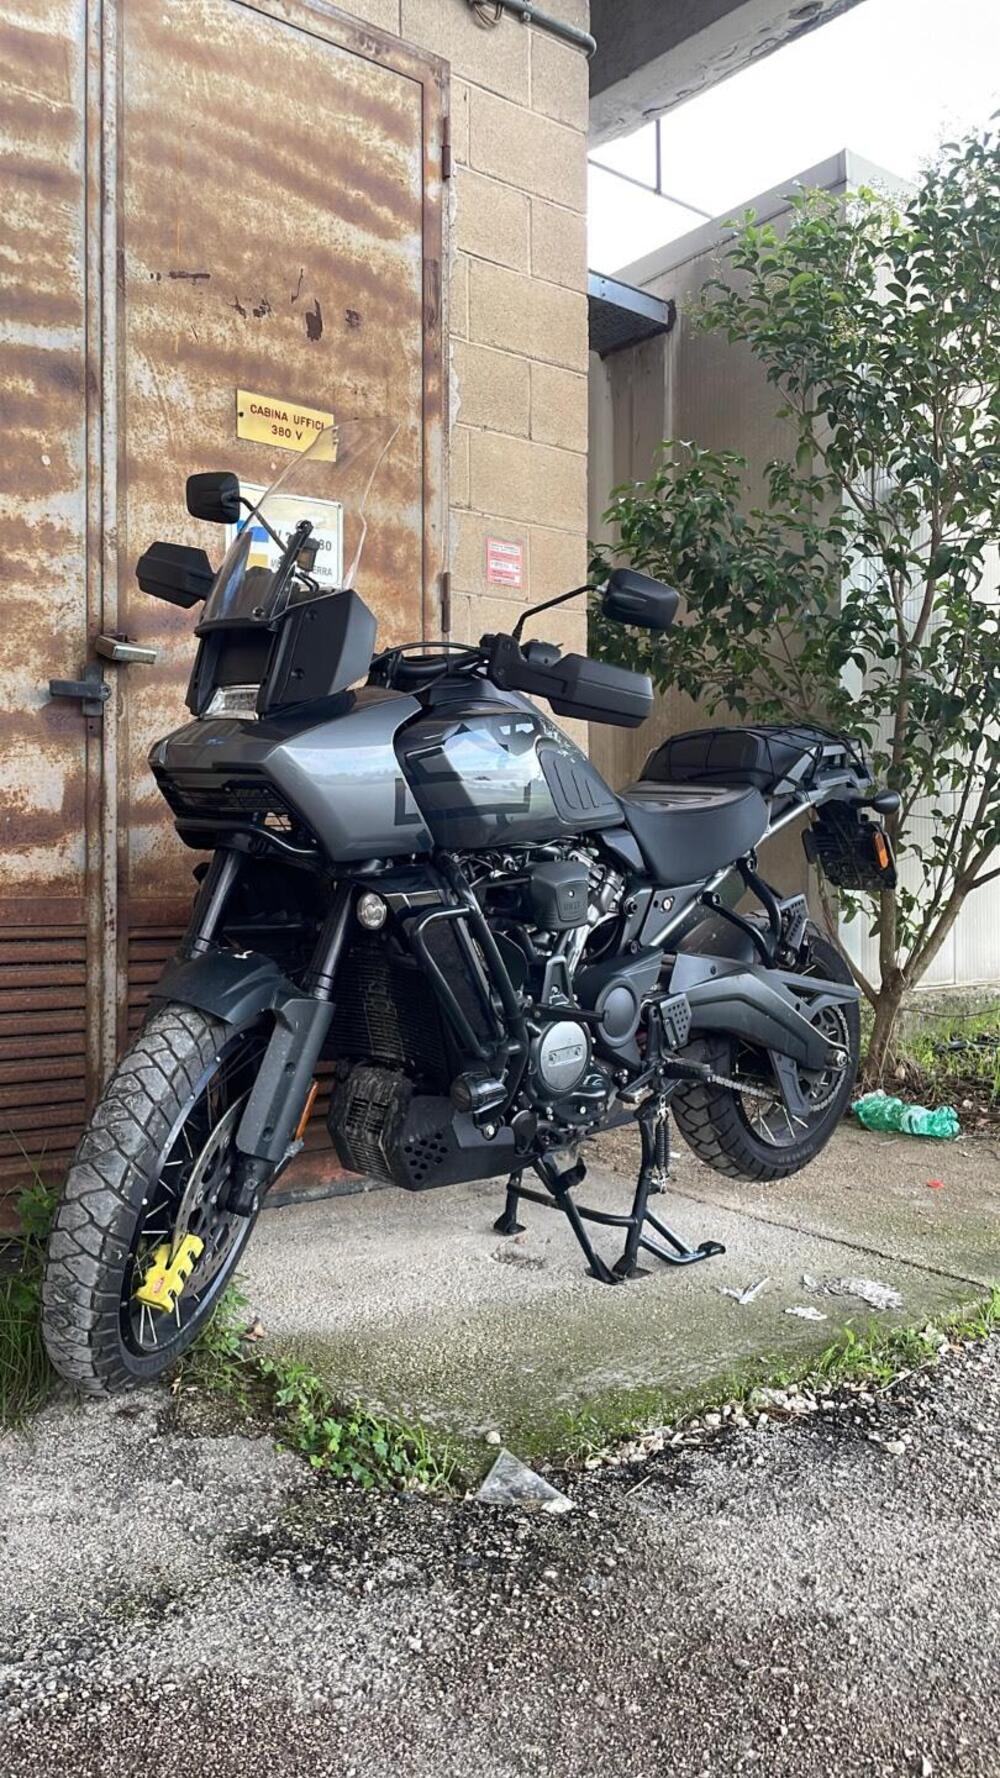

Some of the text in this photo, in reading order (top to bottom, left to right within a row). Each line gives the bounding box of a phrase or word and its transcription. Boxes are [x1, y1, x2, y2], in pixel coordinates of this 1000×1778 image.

[250, 404, 325, 430] CABINA UFFICI
[271, 424, 303, 440] 380 V
